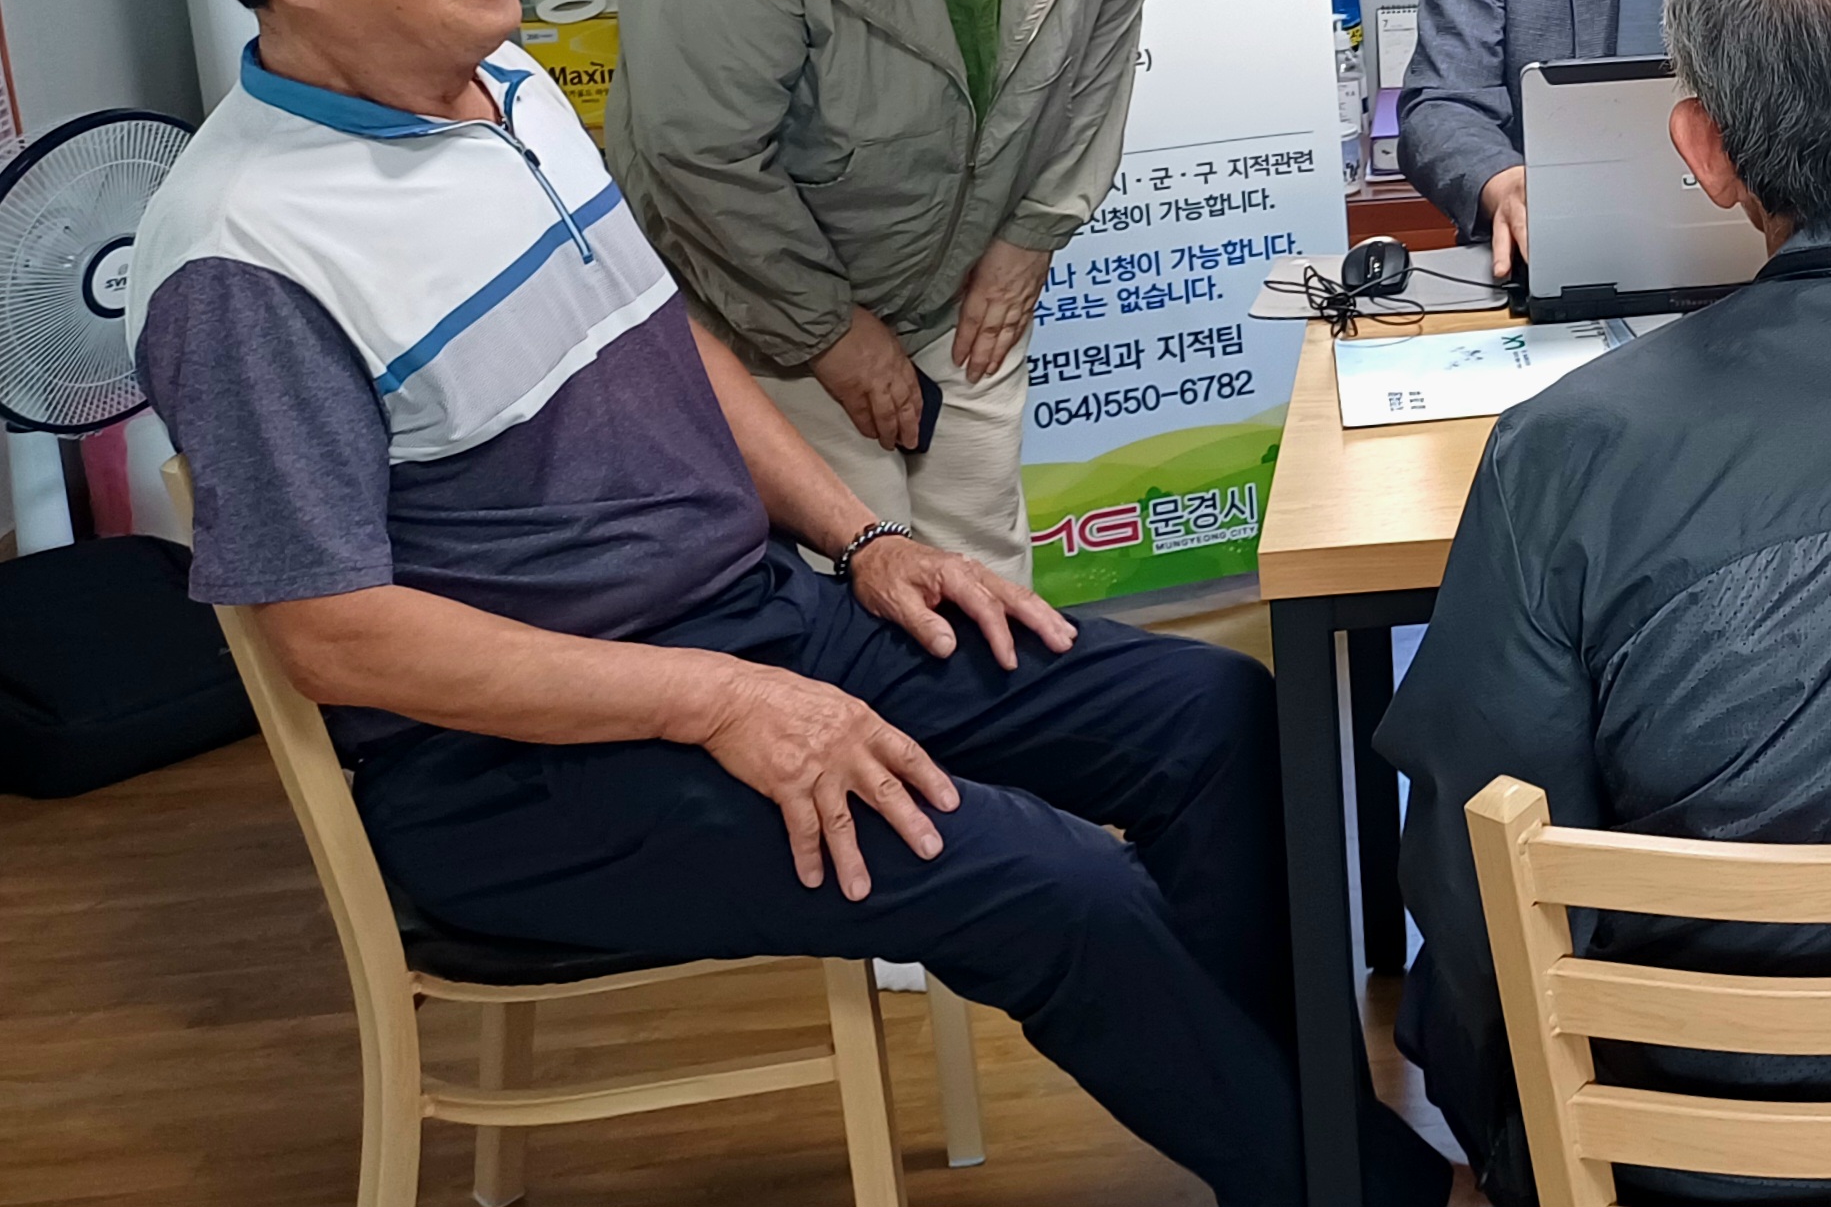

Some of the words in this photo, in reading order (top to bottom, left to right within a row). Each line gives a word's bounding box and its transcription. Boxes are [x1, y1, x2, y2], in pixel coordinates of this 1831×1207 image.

[1227, 150, 1316, 179] 지적관련
[1159, 188, 1276, 223] 가능합니다.
[1086, 251, 1161, 283] 신청이
[1171, 232, 1304, 271] 가능합니다.
[1116, 275, 1223, 314] 없습니다.
[1156, 324, 1244, 364] 지적팀
[1034, 370, 1255, 429] 054)550-6782
[1149, 484, 1256, 538] 문경시
[1155, 531, 1227, 552] MUNGYEONG
[1230, 525, 1255, 539] CITY
